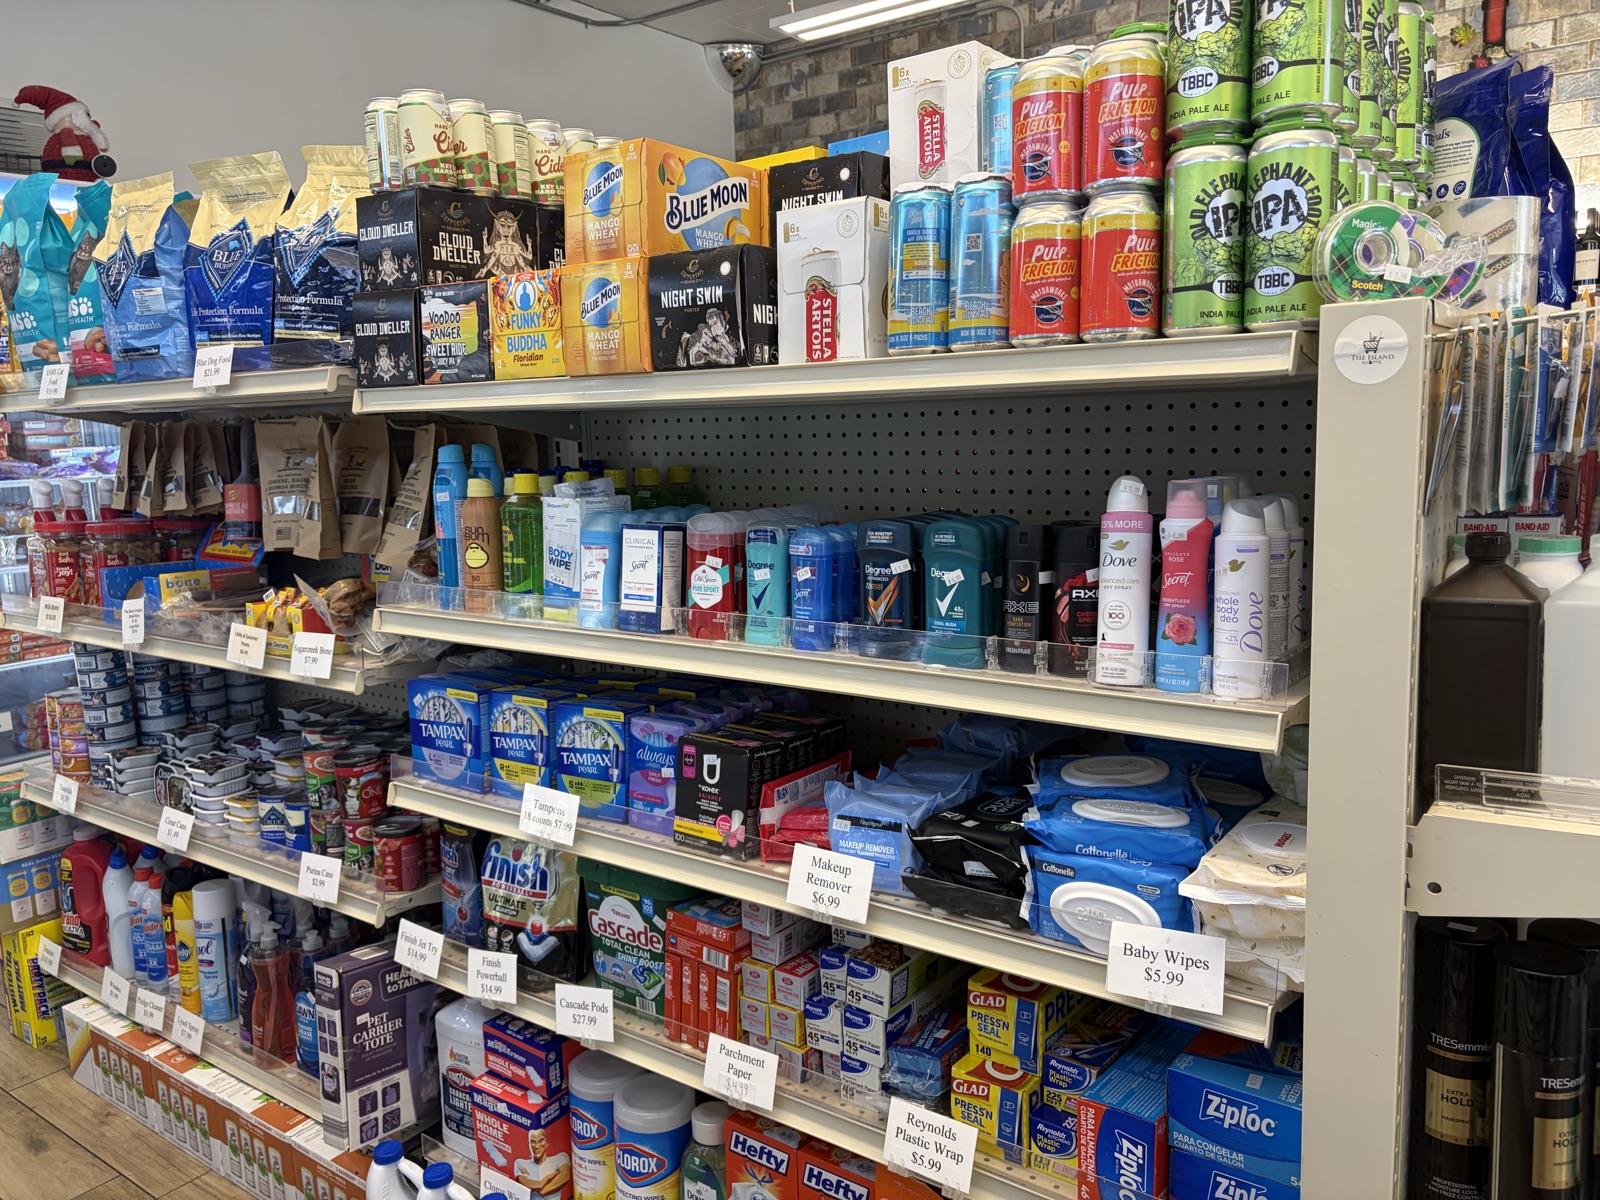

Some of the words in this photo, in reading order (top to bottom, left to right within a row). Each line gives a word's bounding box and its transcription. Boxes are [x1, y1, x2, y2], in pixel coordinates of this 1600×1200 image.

[1182, 73, 1213, 92] TBBC
[1109, 82, 1147, 102] PULP
[1255, 95, 1273, 107] PALE
[1274, 90, 1291, 100] ALE
[1021, 100, 1053, 121] PULP
[1014, 113, 1066, 141] FRICTION
[924, 116, 932, 163] ARTOIS
[584, 180, 603, 206] BLUE
[603, 166, 623, 187] MOON
[666, 195, 708, 230] BLUE
[710, 182, 748, 204] MOON
[1254, 189, 1306, 234] IPA
[359, 227, 380, 241] CLOUD
[382, 221, 414, 238] DWELLER
[587, 217, 620, 231] MANGO
[439, 232, 473, 248] CLOUD
[588, 229, 619, 240] WHEAT
[695, 228, 724, 240] MANGO
[1124, 235, 1156, 253] PULP
[212, 250, 243, 263] BLUE
[433, 246, 481, 264] DWELLER
[1031, 245, 1067, 262] PULP
[1022, 260, 1077, 281] FRICTION
[1258, 273, 1290, 289] TBBC
[1351, 280, 1383, 291] Scotch
[581, 296, 600, 319] BLUE
[601, 282, 621, 304] MOON
[661, 289, 694, 309] NIGHT
[697, 286, 723, 305] SWIM
[1030, 286, 1068, 300] MOTORWORKS
[356, 324, 377, 336] CLOUD
[379, 321, 410, 335] DWELLER
[511, 311, 542, 330] FUNKY
[822, 297, 832, 359] STELLA
[430, 325, 462, 341] RANGER
[587, 330, 620, 341] MANGO
[811, 298, 822, 360] ARTOIS
[507, 333, 547, 352] BUDDHA
[588, 339, 619, 350] WHEAT
[196, 358, 207, 367] Blue
[208, 357, 217, 366] Dog
[218, 354, 231, 363] Food
[204, 368, 220, 377] $21.99
[1463, 523, 1498, 532] BAND-AID
[1515, 522, 1550, 532] BAND-AID
[625, 537, 655, 545] CLINICAL
[549, 549, 573, 560] BODY
[1102, 552, 1137, 568] Dove
[549, 559, 571, 570] WIPE
[632, 560, 649, 572] Secret
[748, 560, 775, 570] Degree
[865, 564, 891, 575] Degree
[165, 577, 200, 589] bone
[583, 571, 601, 581] Secret
[1162, 572, 1194, 588] Secret
[1003, 601, 1039, 613] AXE
[1216, 606, 1239, 616] body
[1219, 614, 1239, 623] deo
[1240, 591, 1264, 653] Dove
[294, 644, 318, 654] Sugarcreek
[320, 647, 332, 655] Bone
[304, 656, 318, 664] $7.99
[420, 723, 466, 741] TAMPAX
[436, 739, 455, 748] PEARL
[493, 737, 537, 751] TAMPAX
[508, 749, 526, 758] PEARL
[561, 752, 612, 766] TAMPAX
[637, 746, 675, 768] always
[362, 784, 382, 799] ONE
[534, 799, 565, 816] Tampons
[165, 817, 176, 827] Cesar
[177, 821, 187, 831] Cans
[167, 829, 180, 838] $1.49
[675, 833, 684, 842] 100
[1273, 832, 1292, 848] HUGGIES
[839, 839, 864, 850] MAKEUP
[865, 843, 895, 854] REMOVER
[1075, 844, 1128, 859] Cottonelle
[306, 866, 321, 877] Purina
[321, 869, 334, 878] Cans
[811, 855, 852, 877] Makeup
[1042, 861, 1075, 878] Cottonelle
[312, 878, 325, 887] $2.99
[806, 872, 853, 894] Remover
[488, 892, 527, 911] ULTIMATE
[812, 891, 840, 908] $6.99
[588, 909, 663, 952] Cascade
[833, 928, 846, 939] 45
[407, 948, 427, 962] $14.99
[601, 937, 623, 951] TOTAL
[624, 945, 650, 959] CLEAN
[482, 956, 501, 968] Finish
[617, 952, 638, 965] SHINE
[639, 958, 664, 969] BOOST
[1122, 942, 1159, 964] Baby
[1163, 948, 1210, 971] Wipes
[476, 969, 507, 982] Powerball
[1143, 966, 1184, 987] $5.99
[481, 983, 503, 995] $14.99
[823, 981, 835, 991] 45
[559, 998, 590, 1011] Cascade
[591, 1003, 609, 1014] Pods
[969, 992, 1005, 1008] GLAD
[177, 1015, 187, 1028] Lysol
[188, 1021, 199, 1035] Spray
[366, 1011, 389, 1027] PET
[572, 1013, 597, 1026] $27.99
[353, 1018, 403, 1044] CARRIER
[808, 1031, 820, 1042] 45
[977, 1022, 1001, 1038] SEAL
[363, 1032, 394, 1051] TOTE
[845, 1040, 858, 1052] 45
[975, 1043, 992, 1056] 140
[1430, 1032, 1488, 1052] TRESemmé
[719, 1043, 765, 1069] Parchment
[488, 1054, 509, 1070] WHOLE
[509, 1063, 527, 1078] HOME
[727, 1063, 752, 1081] Paper
[1050, 1059, 1079, 1075] Reynolds
[1049, 1070, 1073, 1084] Plastic
[1049, 1076, 1068, 1088] Wrap
[725, 1078, 748, 1094] $4.99
[952, 1080, 989, 1096] GLAD
[1446, 1088, 1469, 1097] EXTRA
[1046, 1090, 1063, 1102] 225
[1441, 1094, 1474, 1107] HOLD
[475, 1110, 509, 1134] WHOLE
[961, 1111, 985, 1128] SEAL
[1206, 1094, 1275, 1137] Ziploc
[476, 1121, 504, 1142] HOME
[906, 1112, 957, 1142] Reynolds
[1037, 1123, 1066, 1139] Reynolds
[894, 1127, 931, 1152] Plastic
[934, 1141, 964, 1165] Wrap
[1036, 1134, 1060, 1149] Plastic
[1037, 1141, 1056, 1153] Wrap
[1173, 1131, 1195, 1146] PARA
[1197, 1139, 1245, 1162] CONGELAR
[732, 1134, 786, 1171] Hefty
[911, 1152, 942, 1173] $5.99
[1433, 1176, 1476, 1190] PROFESSIONAL
